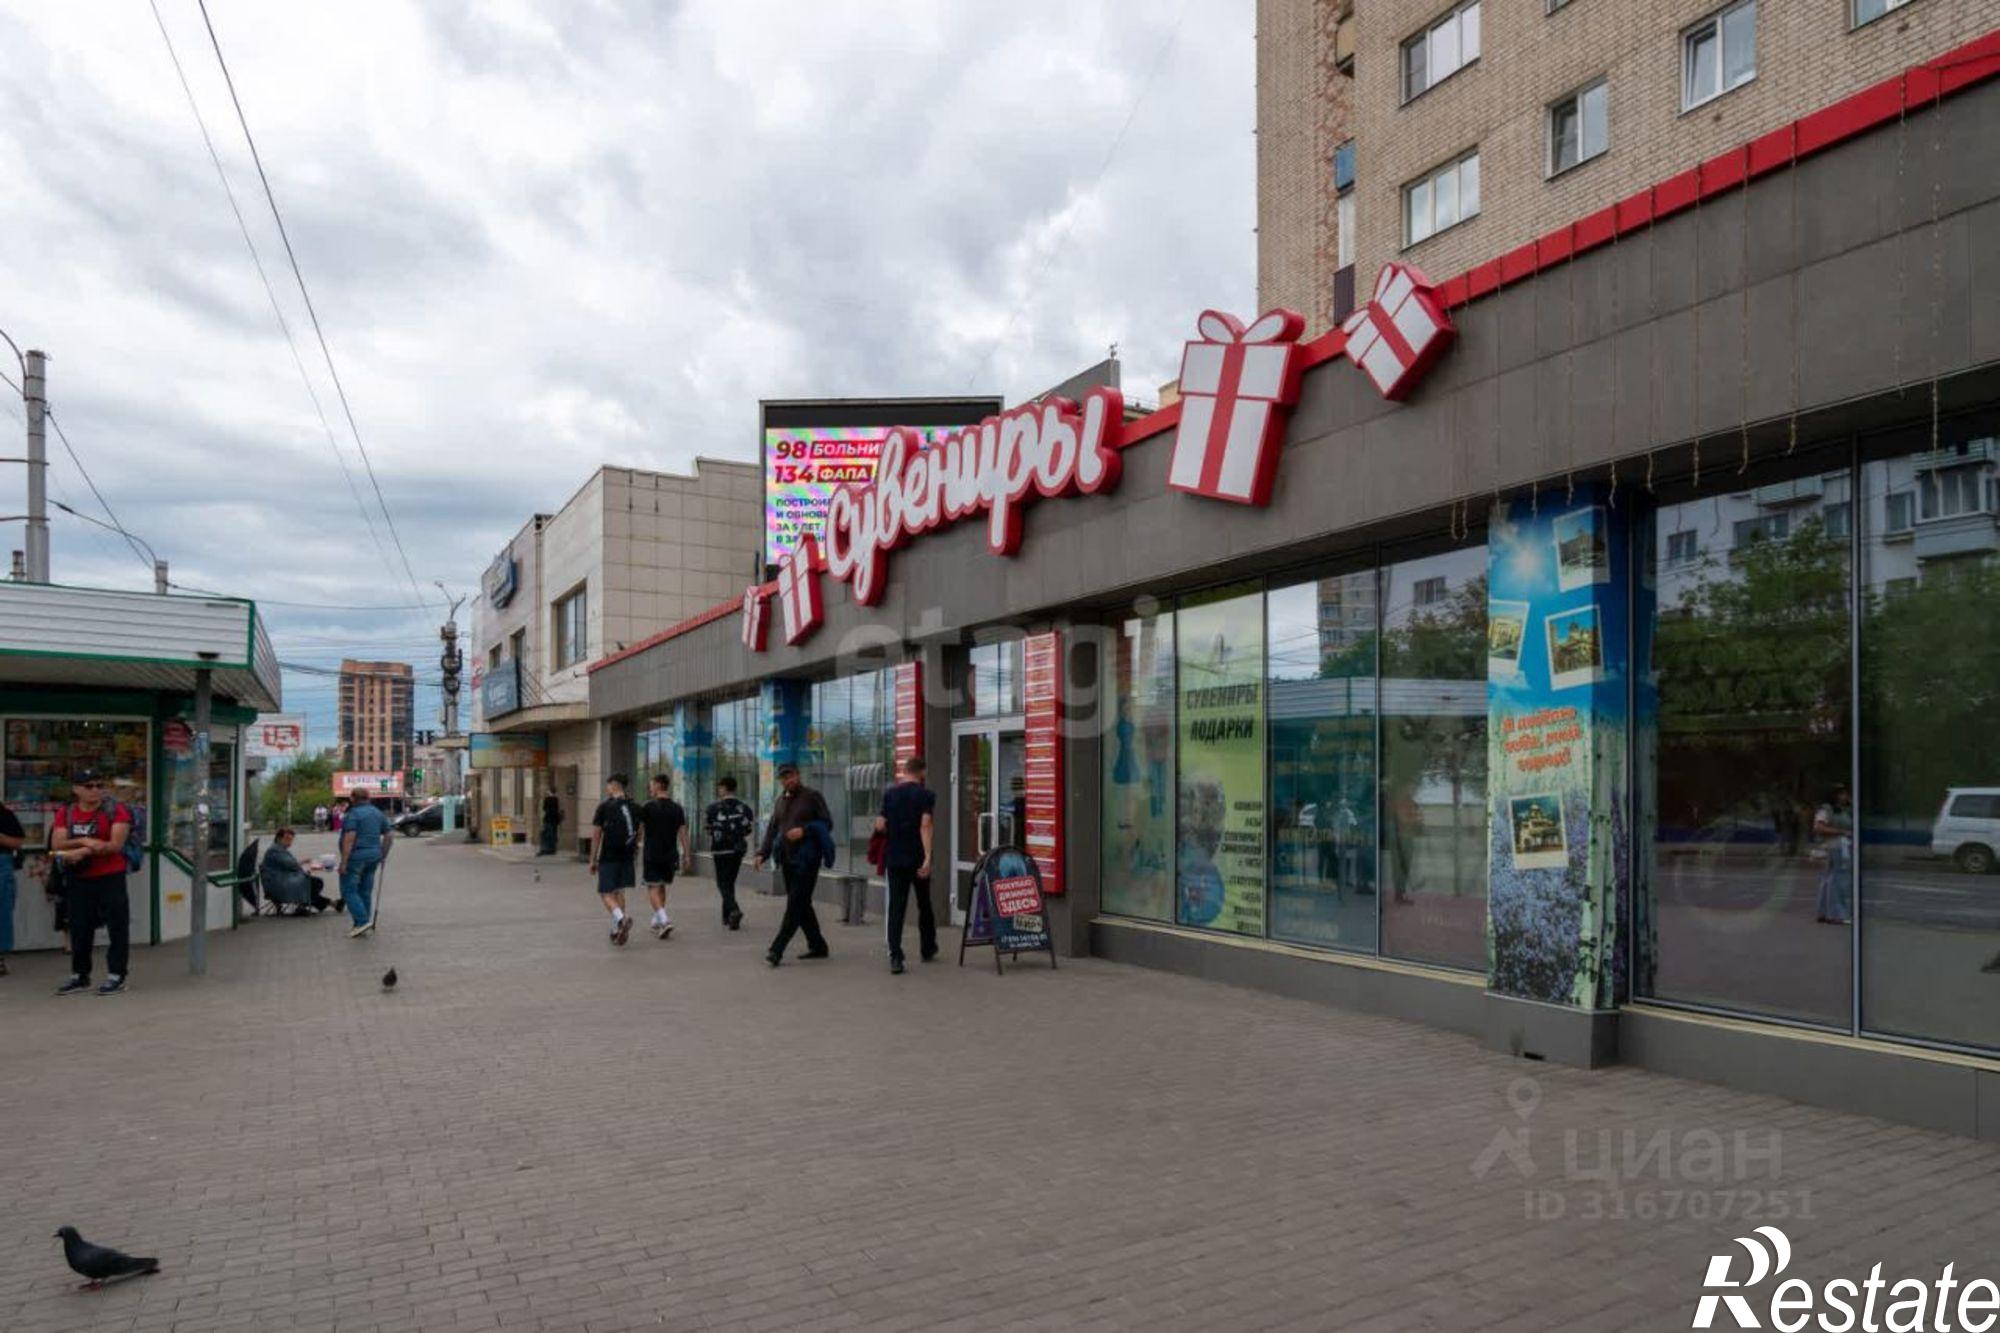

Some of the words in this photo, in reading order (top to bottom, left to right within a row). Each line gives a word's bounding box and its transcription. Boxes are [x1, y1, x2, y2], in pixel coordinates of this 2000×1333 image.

[776, 441, 808, 460] 98
[813, 443, 885, 457] БОЛЬНИ
[774, 464, 813, 484] 134
[820, 467, 868, 480] ФАПА
[827, 390, 1110, 604] Сувениры
[1187, 682, 1259, 710] СУВЕНИРЫ
[1190, 715, 1255, 746] ПОДАРКИ
[1001, 898, 1039, 913] ЗДЕСЬ
